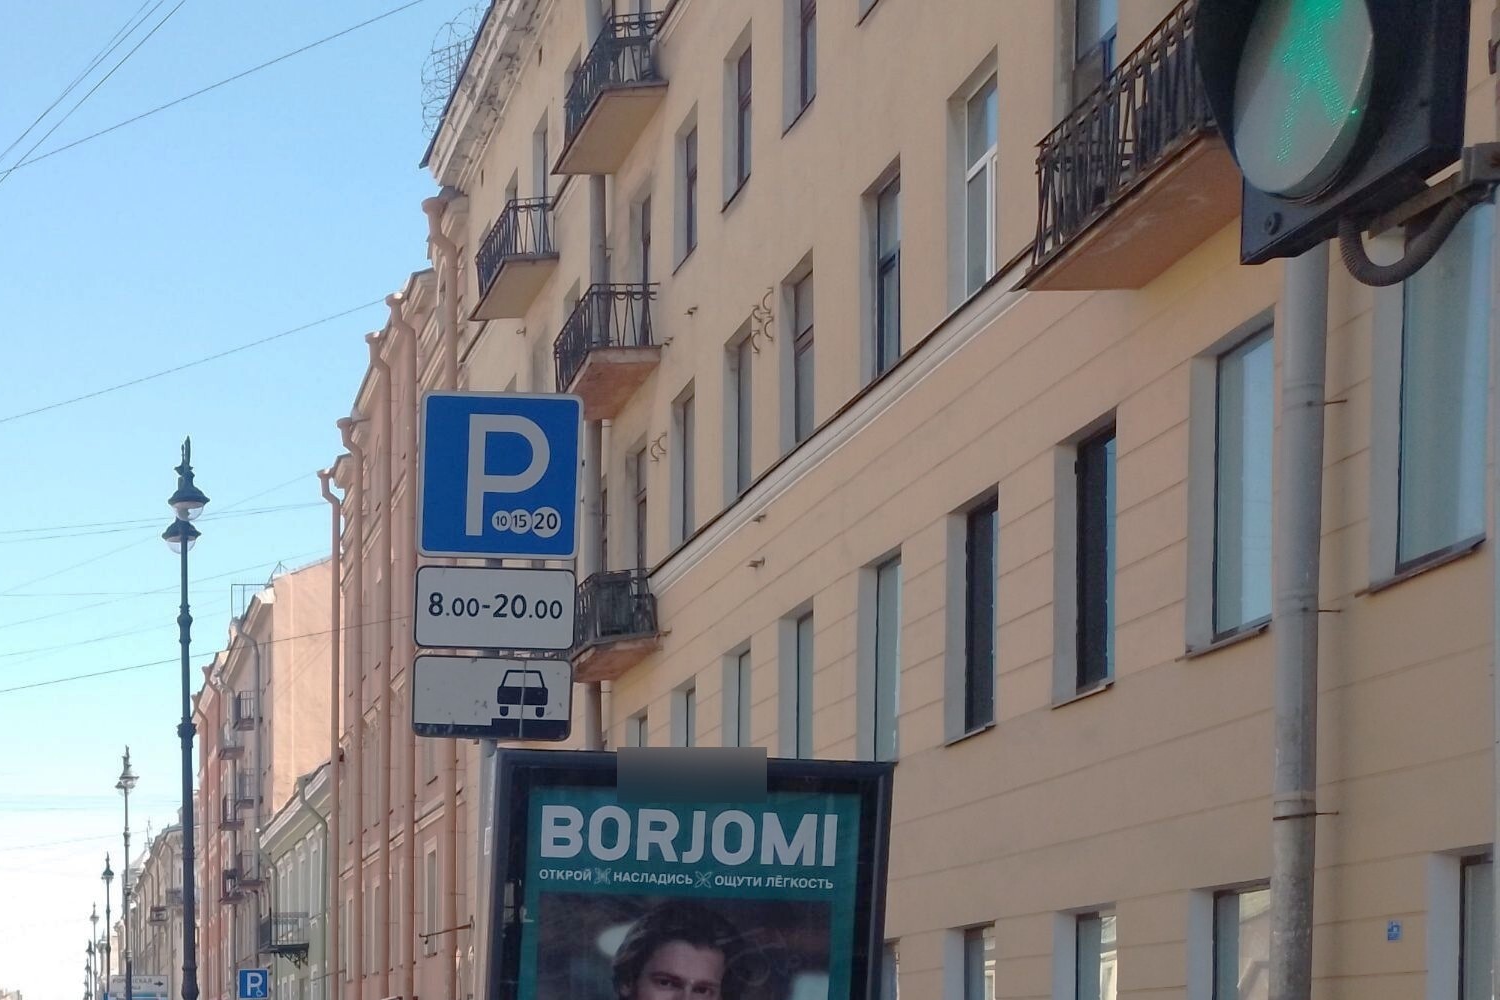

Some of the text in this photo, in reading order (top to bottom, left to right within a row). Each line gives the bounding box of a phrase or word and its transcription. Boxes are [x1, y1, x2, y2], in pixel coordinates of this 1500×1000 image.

[465, 413, 550, 536] P
[495, 512, 558, 530] 10 15 20
[427, 592, 563, 620] 8.00-20.00
[539, 804, 839, 867] BORJOMI
[539, 868, 834, 890] ОТКРОЙ НАСЛАДИСЬ ОЩУТИ ЛЁГКОСТЬ
[246, 972, 263, 996] P
